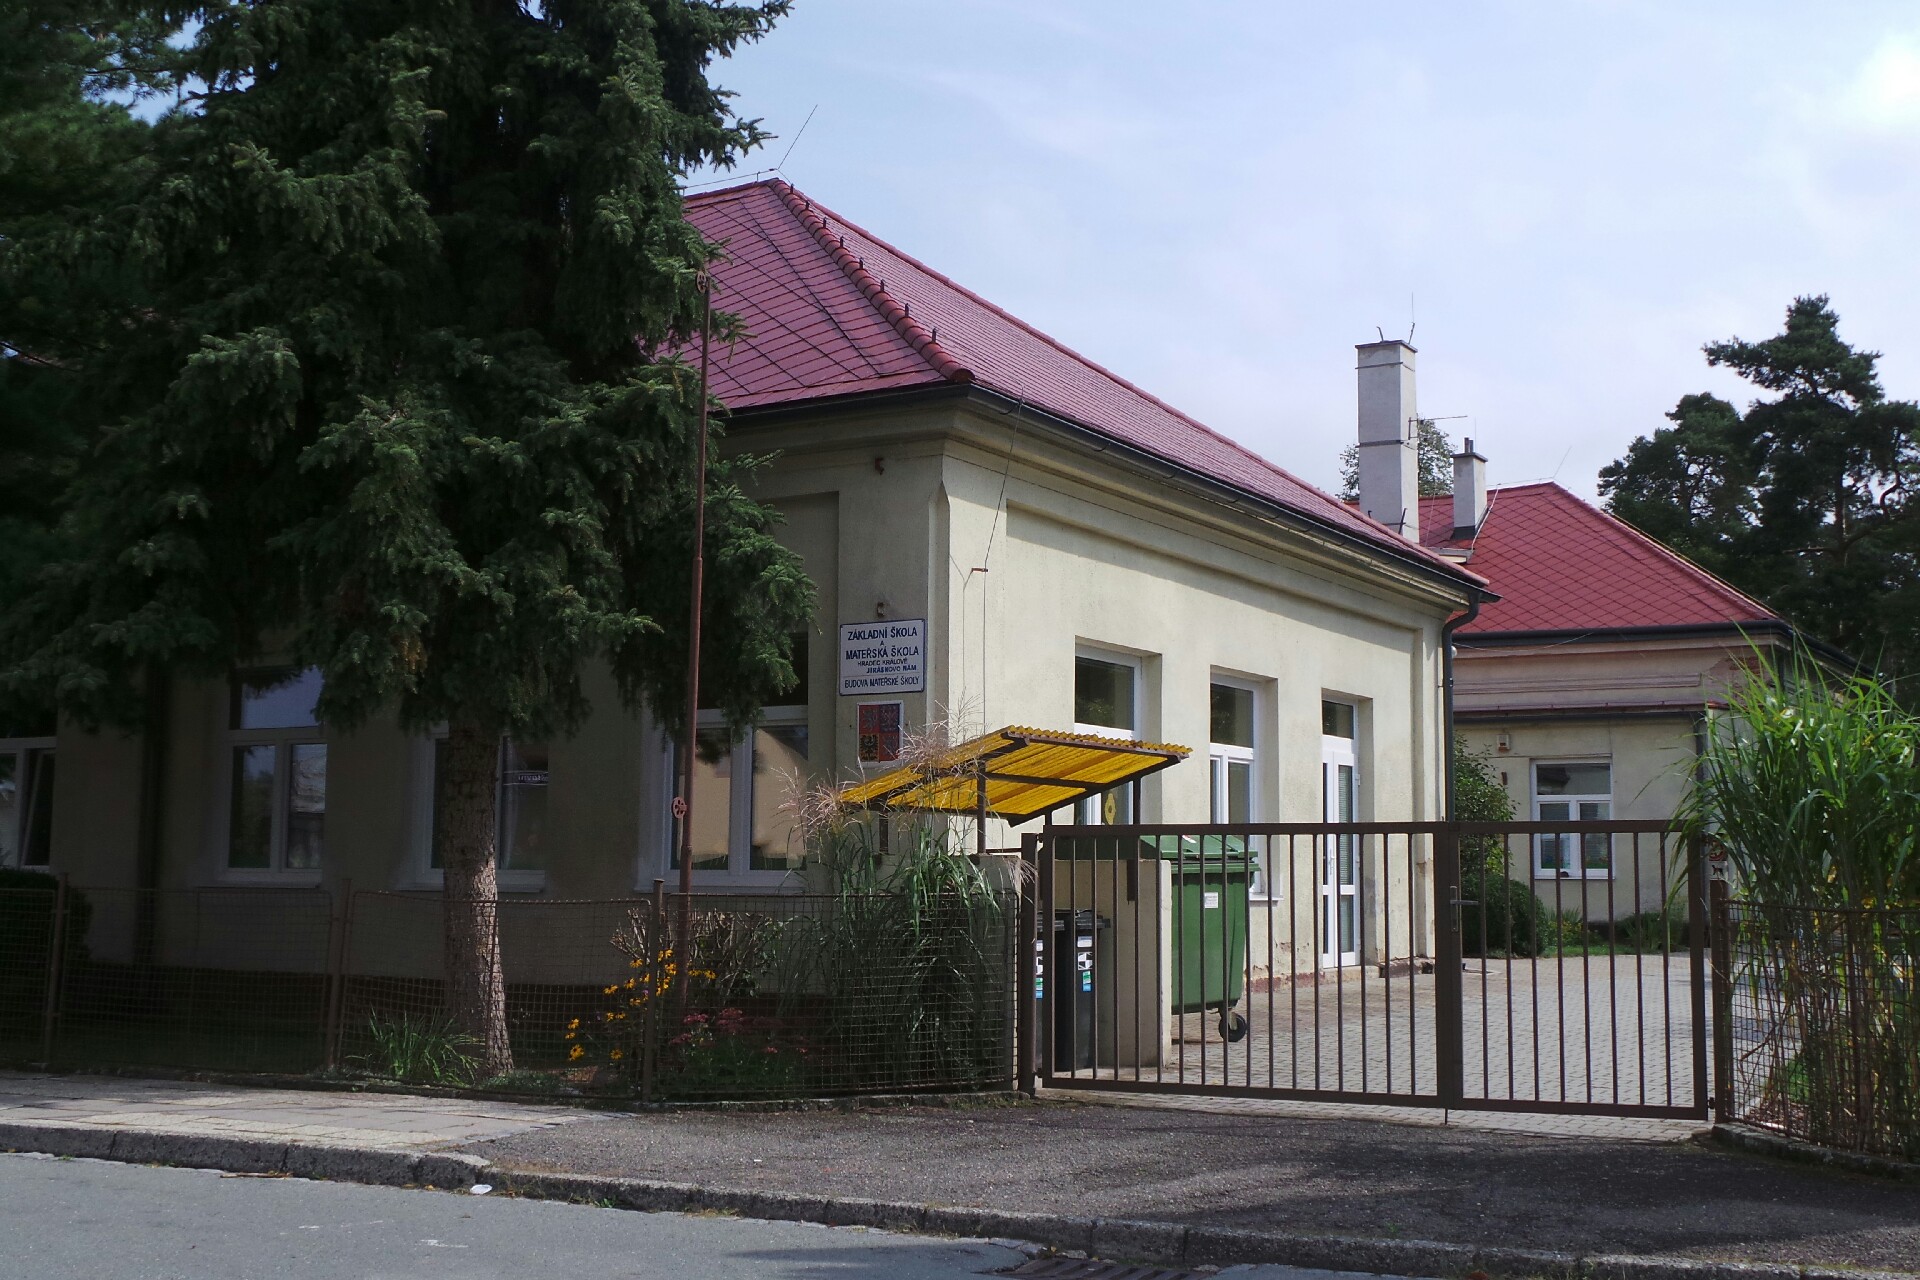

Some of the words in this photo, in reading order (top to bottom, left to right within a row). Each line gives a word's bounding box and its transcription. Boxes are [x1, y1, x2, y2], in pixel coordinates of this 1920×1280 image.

[848, 626, 888, 640] ZÁKLADNÍ
[890, 626, 918, 638] ŠKOLA
[846, 646, 888, 660] MATEŘSKÁ
[890, 645, 920, 656] ŠKOLA
[844, 679, 868, 688] BUDOVA
[870, 676, 898, 686] MATEŘSKÉ
[900, 675, 920, 686] ŠKOLY
